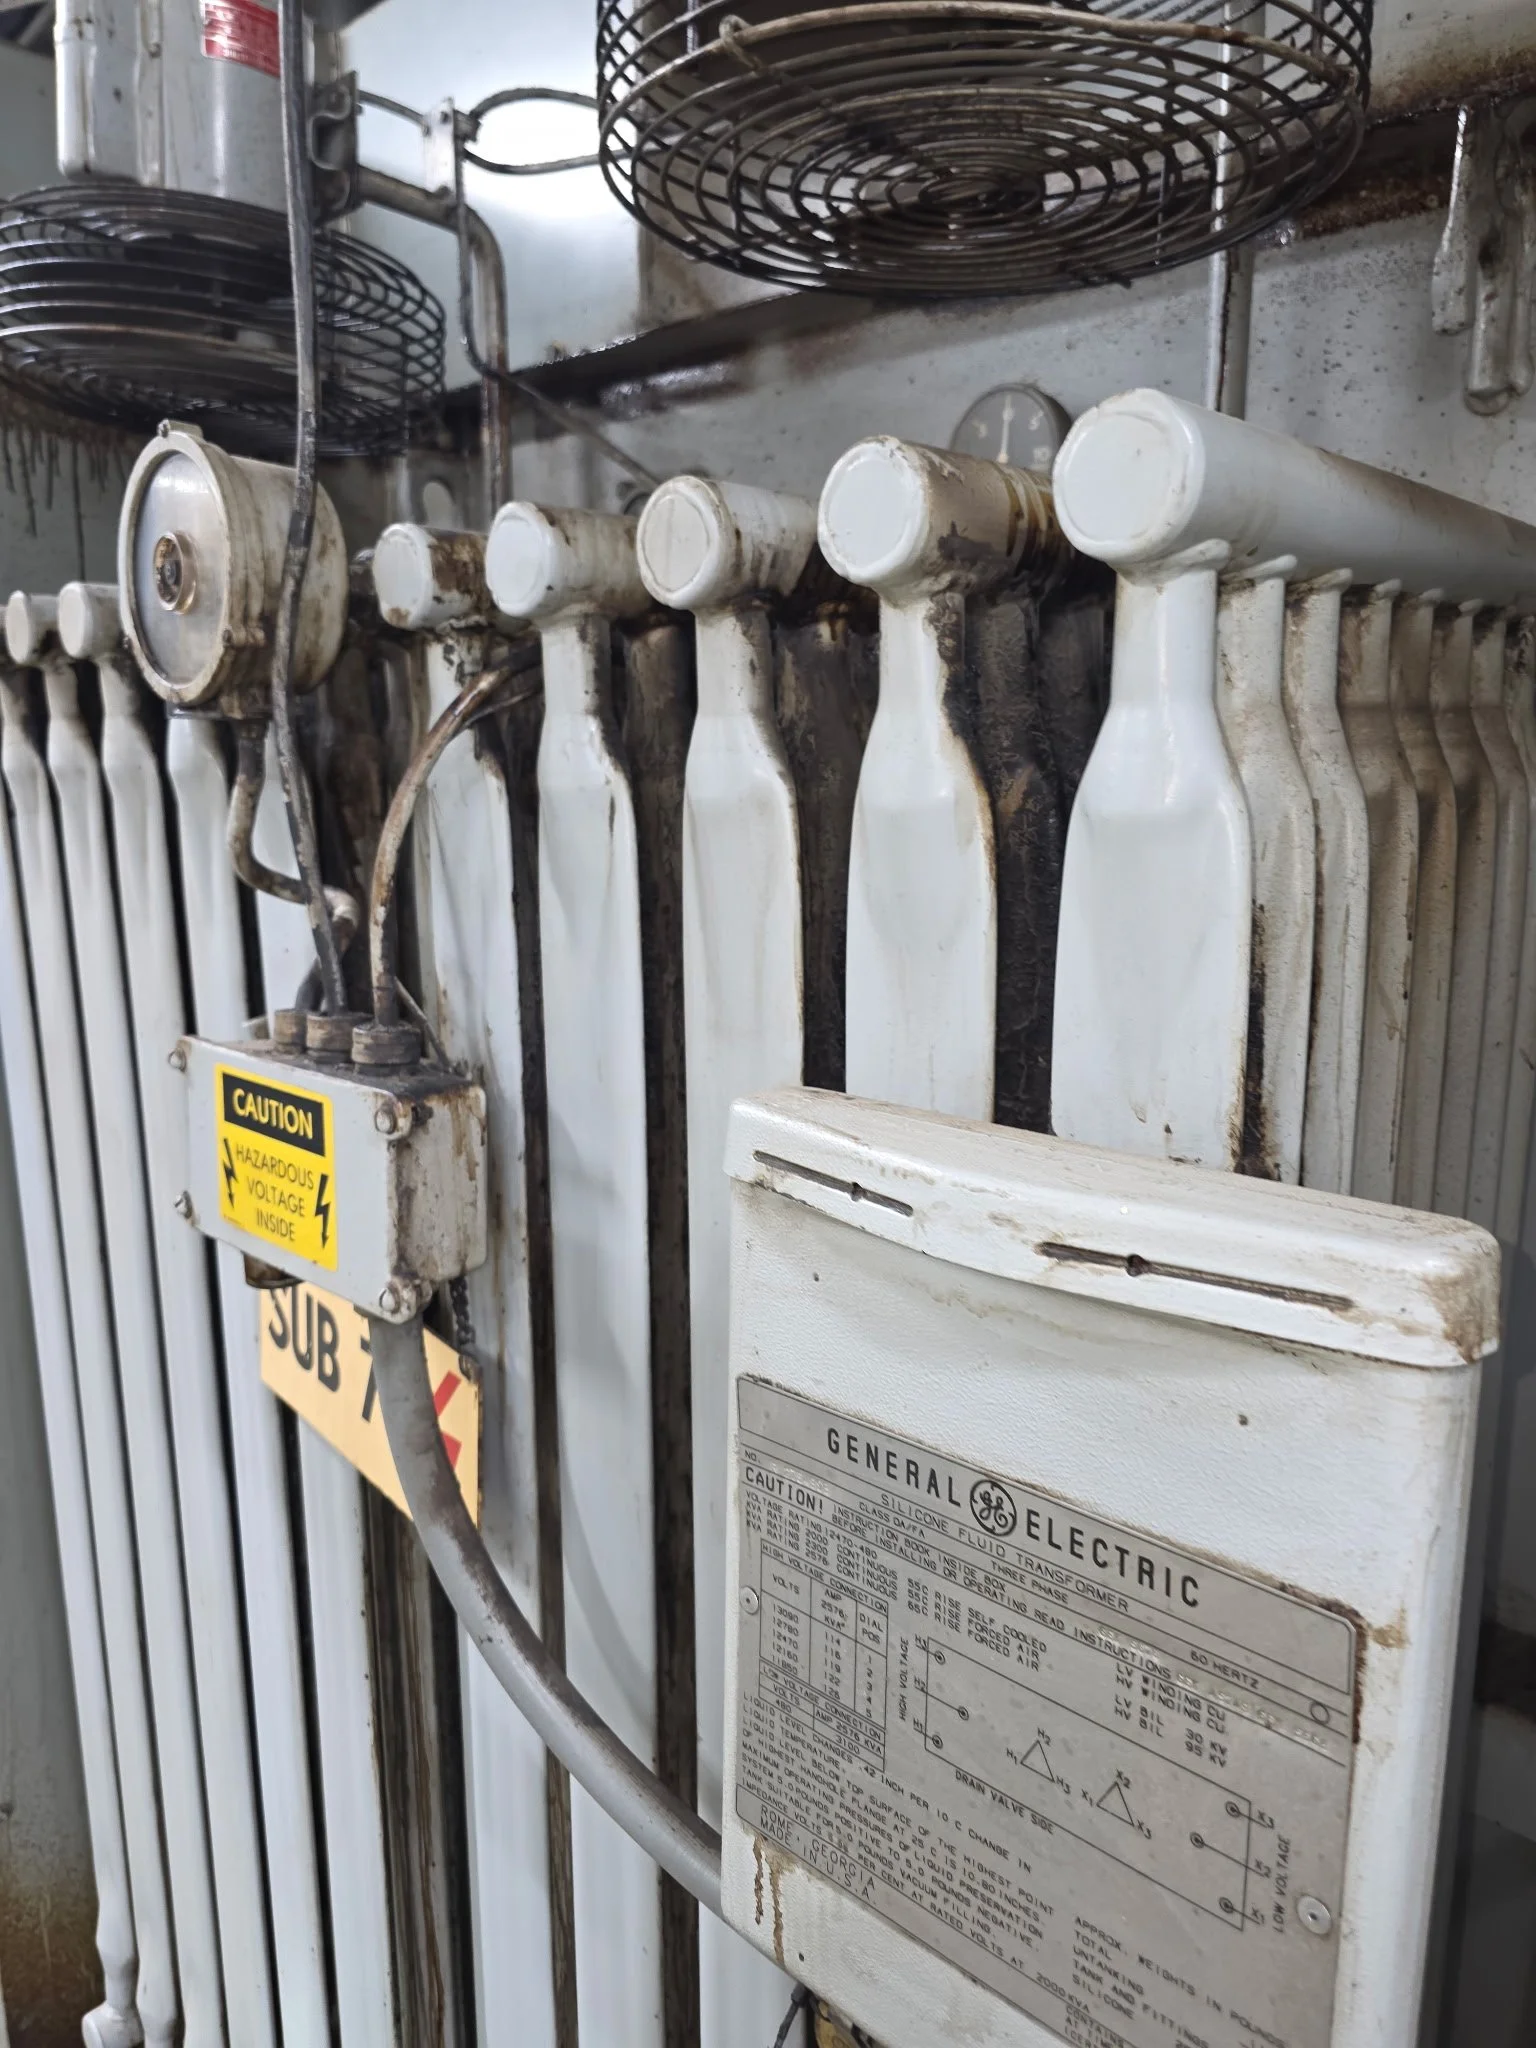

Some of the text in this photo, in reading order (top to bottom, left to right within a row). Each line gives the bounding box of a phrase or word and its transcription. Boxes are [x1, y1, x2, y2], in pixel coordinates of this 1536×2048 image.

[232, 1087, 313, 1140] CAUTION
[235, 1143, 314, 1191] HAZARDOUS
[246, 1175, 305, 1218] VOLTAGE
[256, 1209, 296, 1242] INSIDE
[268, 1285, 342, 1393] SUB
[744, 1449, 760, 1464] NO.
[745, 1464, 822, 1515] CAUTION!
[745, 1489, 782, 1514] VOLTAGE
[788, 1509, 821, 1533] RATING
[827, 1425, 961, 1508] GENERAL
[1026, 1508, 1199, 1610] ELECTRIC
[859, 1501, 889, 1523] CLASS
[833, 1504, 1005, 1593] INSTRUCTION BOOK INSIDE BOX
[881, 1493, 1128, 1613] SILICONE FLUID TRANSFORMER
[746, 1499, 1047, 1653] KVA RATING 2000 CONTINUOUS 55C RISE SELF COOLED
[746, 1509, 1039, 1661] KVA RATING 2300 CONTINUOUS 55C RISE FORCED AIR
[762, 1543, 886, 1613] HIGH VOLTAGE CONNECTION
[772, 1573, 799, 1595] VOLTS
[831, 1513, 866, 1538] BEFORE
[875, 1533, 936, 1571] INSTALLING
[943, 1566, 956, 1580] OR
[964, 1575, 1027, 1614] OPERATING
[1034, 1608, 1064, 1631] READ
[1074, 1625, 1170, 1681] INSTRUCTIONS
[991, 1560, 1068, 1604] THREE PHASE
[824, 1631, 840, 1647] 114
[859, 1612, 882, 1632] DIAL
[862, 1627, 880, 1645] POS
[899, 1635, 908, 1722] HIGH VOLTAGE
[1116, 1662, 1133, 1678] LV
[1190, 1649, 1207, 1666] 60
[1213, 1660, 1259, 1690] HERTZ
[743, 1703, 774, 1729] LIQUID
[773, 1684, 799, 1705] VOLTS
[865, 1707, 872, 1719] 5
[1115, 1693, 1130, 1710] LV
[1139, 1705, 1163, 1726] BIL
[815, 1709, 881, 1755] AMP 2576 KVA
[836, 1734, 859, 1755] 3100
[1037, 1727, 1051, 1747] H2
[1139, 1717, 1163, 1738] BIL
[1006, 1748, 1017, 1765] H1
[1116, 1768, 1130, 1789] X2
[743, 1691, 774, 1717] LIQUID
[780, 1713, 806, 1736] LEVEL
[812, 1733, 852, 1764] CHANGES
[881, 1774, 903, 1795] INCH
[910, 1792, 928, 1811] PER
[937, 1808, 948, 1823] 10
[954, 1819, 961, 1831] C
[969, 1828, 1009, 1860] CHANGE
[1018, 1858, 1031, 1874] IN
[955, 1769, 1053, 1835] DRAIN VALVE SIDE
[1056, 1775, 1070, 1795] H3
[1081, 1788, 1092, 1806] X1
[742, 1765, 762, 1784] TANK
[767, 1781, 810, 1816] SUITABLE
[816, 1812, 833, 1830] FOR
[858, 1839, 893, 1870] POUNDS
[900, 1868, 937, 1900] VACUUM
[743, 1716, 1054, 1917] LIQUID LEVEL BELOW TOP SURFACE OF THE HIGHEST POINT
[1137, 1819, 1151, 1840] X3
[742, 1740, 778, 1769] MAXIMUM
[784, 1766, 833, 1805] OPERATING
[839, 1801, 892, 1843] PRESSURES
[898, 1839, 909, 1854] OF
[914, 1849, 952, 1882] LIQUID
[959, 1878, 1042, 1939] PRESERVATION
[760, 1815, 791, 1847] MADE
[803, 1844, 817, 1865] IN
[761, 1803, 799, 1841] ROME,
[811, 1836, 874, 1890] GEORGIA
[1273, 1833, 1290, 1935] LOW VOLTAGE
[1075, 1930, 1111, 1961] TOTAL
[1073, 1944, 1144, 1997] UNTANKING
[1073, 1959, 1102, 1986] TANK
[1112, 1983, 1134, 2006] AND
[1072, 1973, 1134, 2021] SILICONE
